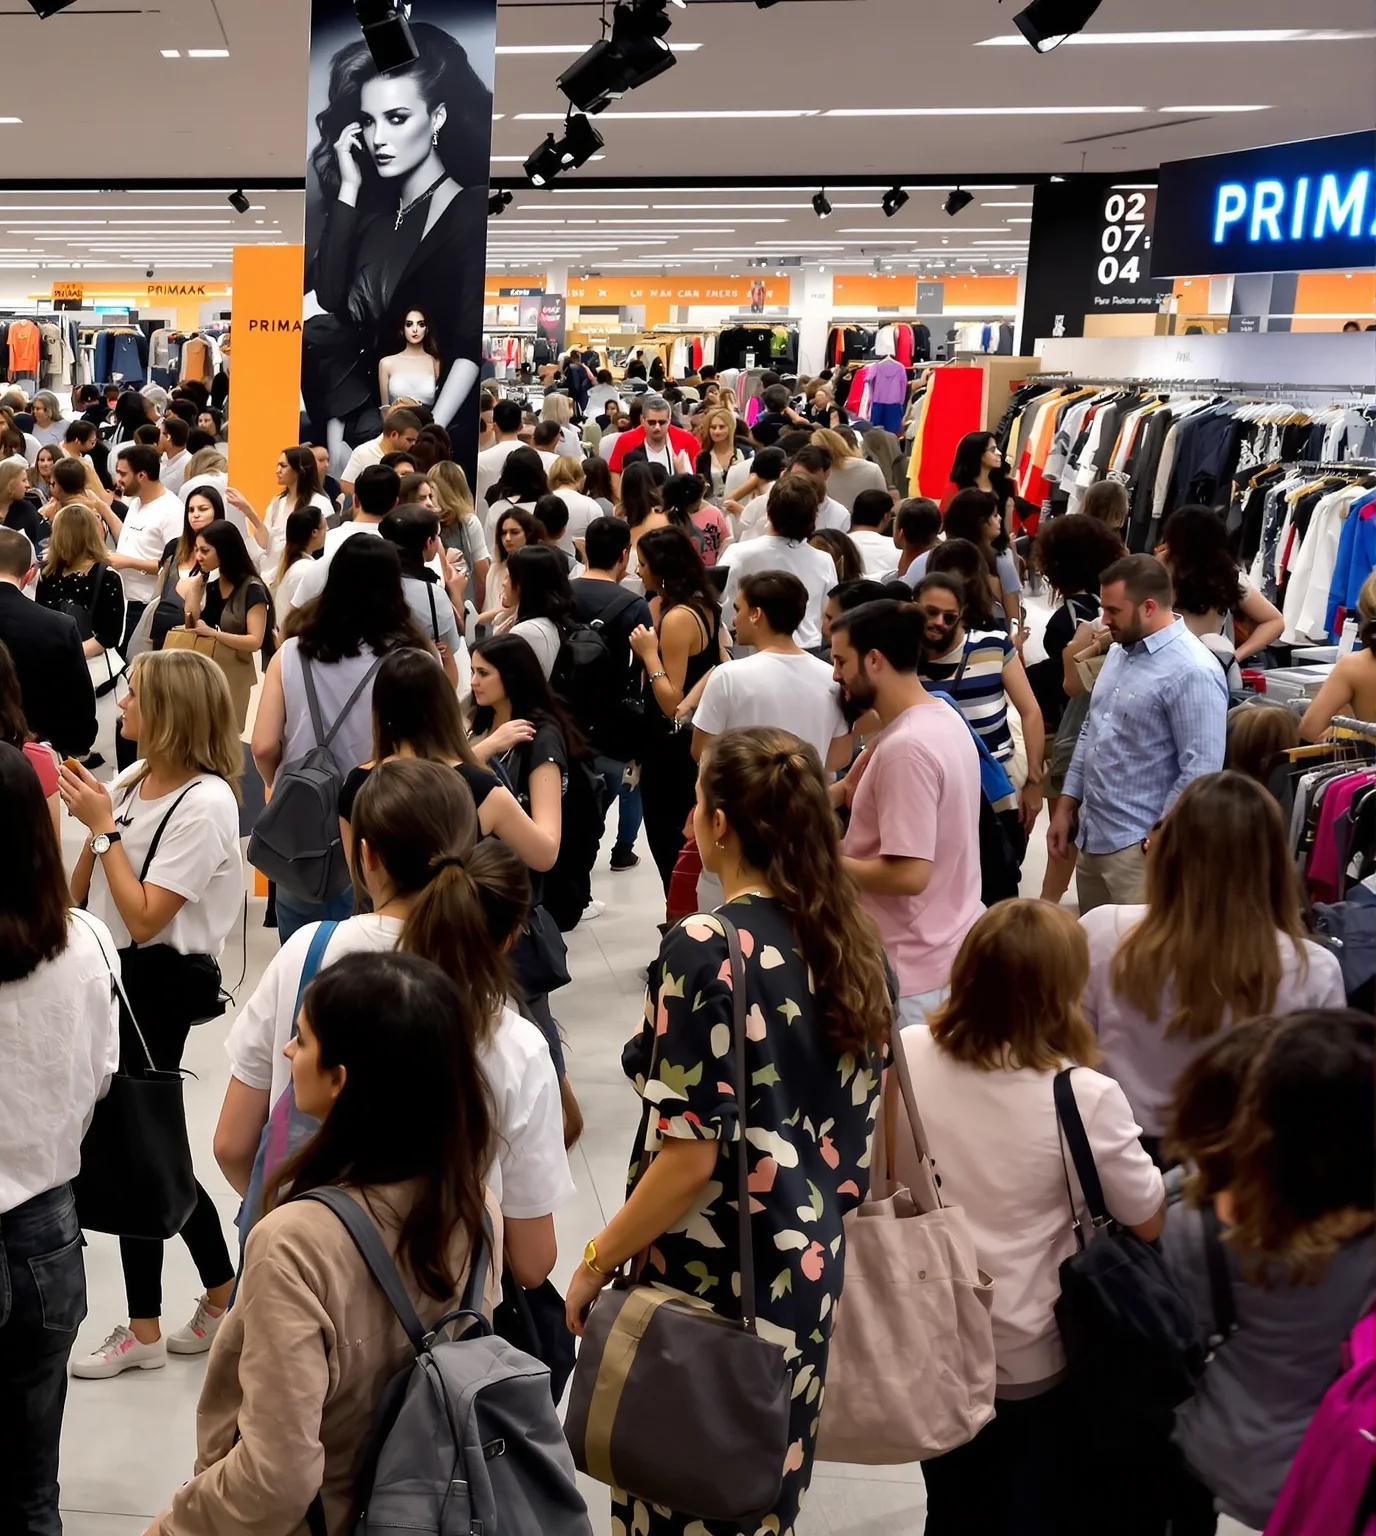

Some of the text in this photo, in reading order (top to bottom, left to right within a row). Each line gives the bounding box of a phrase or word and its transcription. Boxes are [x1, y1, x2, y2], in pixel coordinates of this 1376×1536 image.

[1105, 192, 1146, 223] 02
[1213, 170, 1376, 243] PRIM
[1097, 256, 1140, 285] 04
[248, 319, 302, 332] PRIMA
